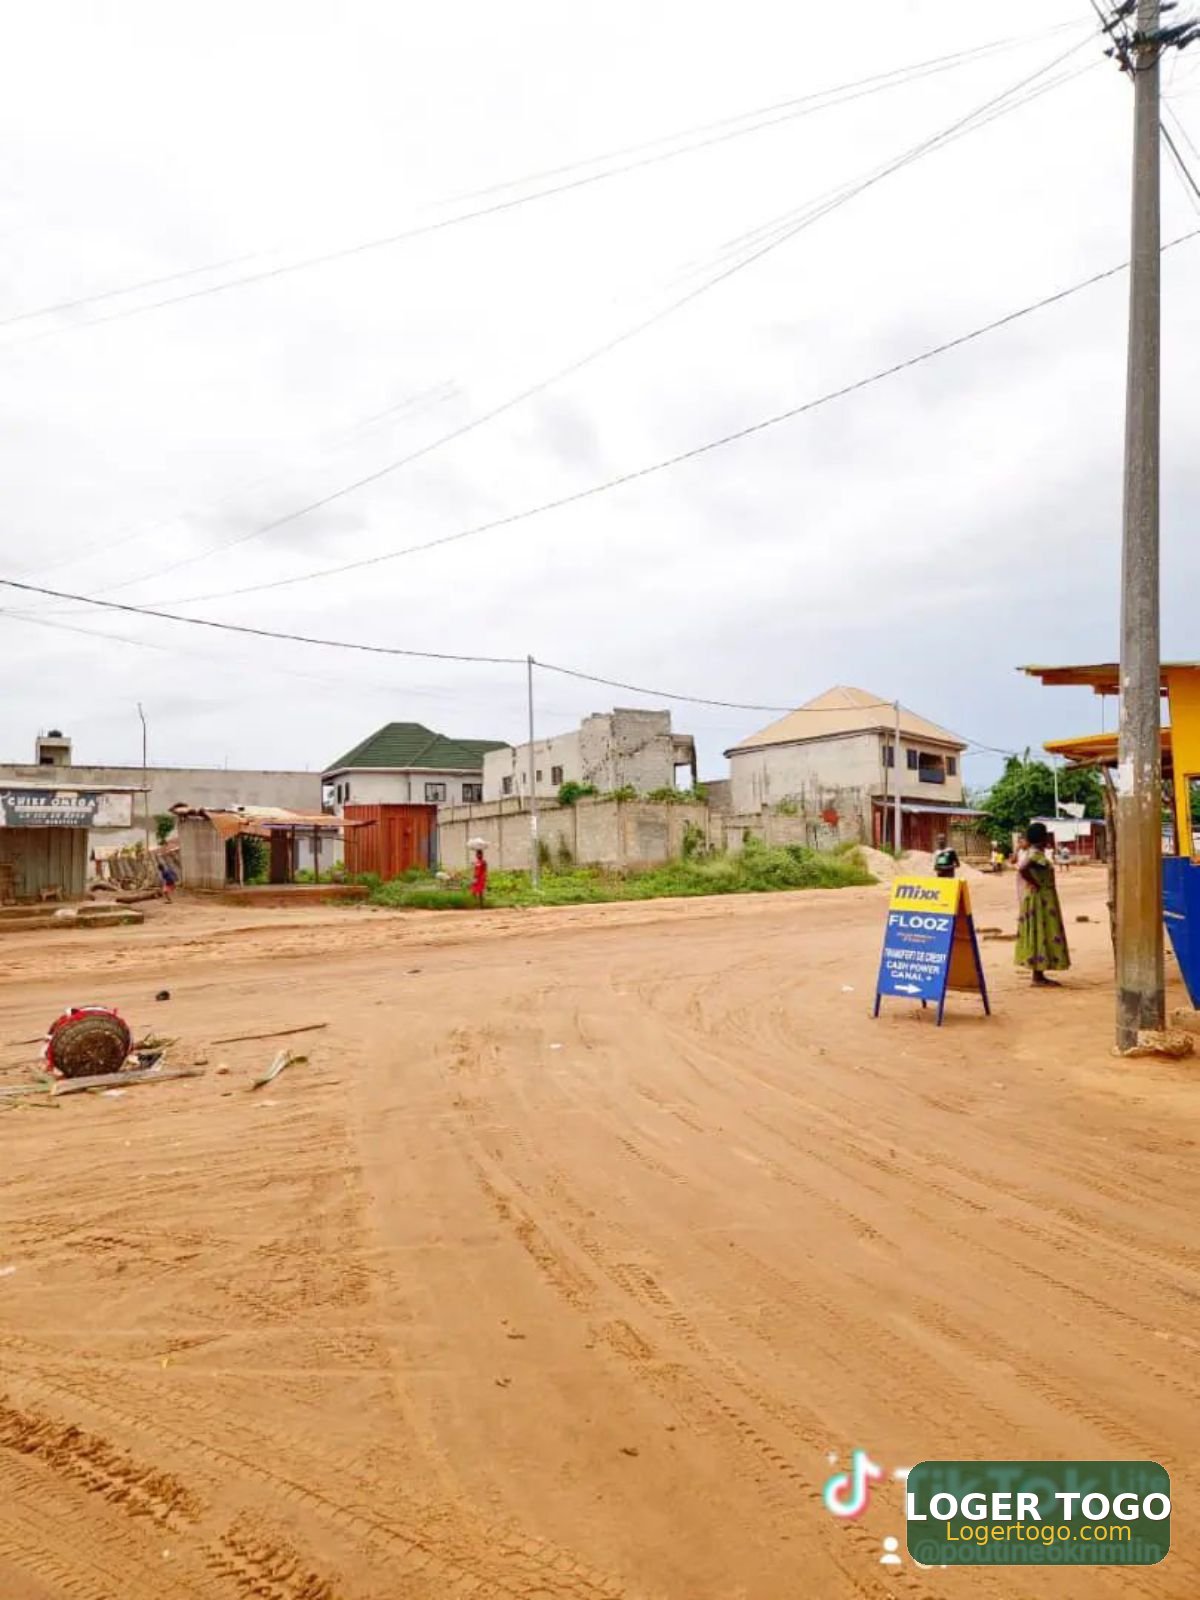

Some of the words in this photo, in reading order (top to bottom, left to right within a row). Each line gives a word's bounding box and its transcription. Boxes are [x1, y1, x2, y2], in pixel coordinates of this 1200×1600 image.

[889, 914, 949, 932] FLOOZ
[887, 960, 909, 971] CASH
[910, 963, 940, 975] POWER
[891, 969, 924, 982] CANAL
